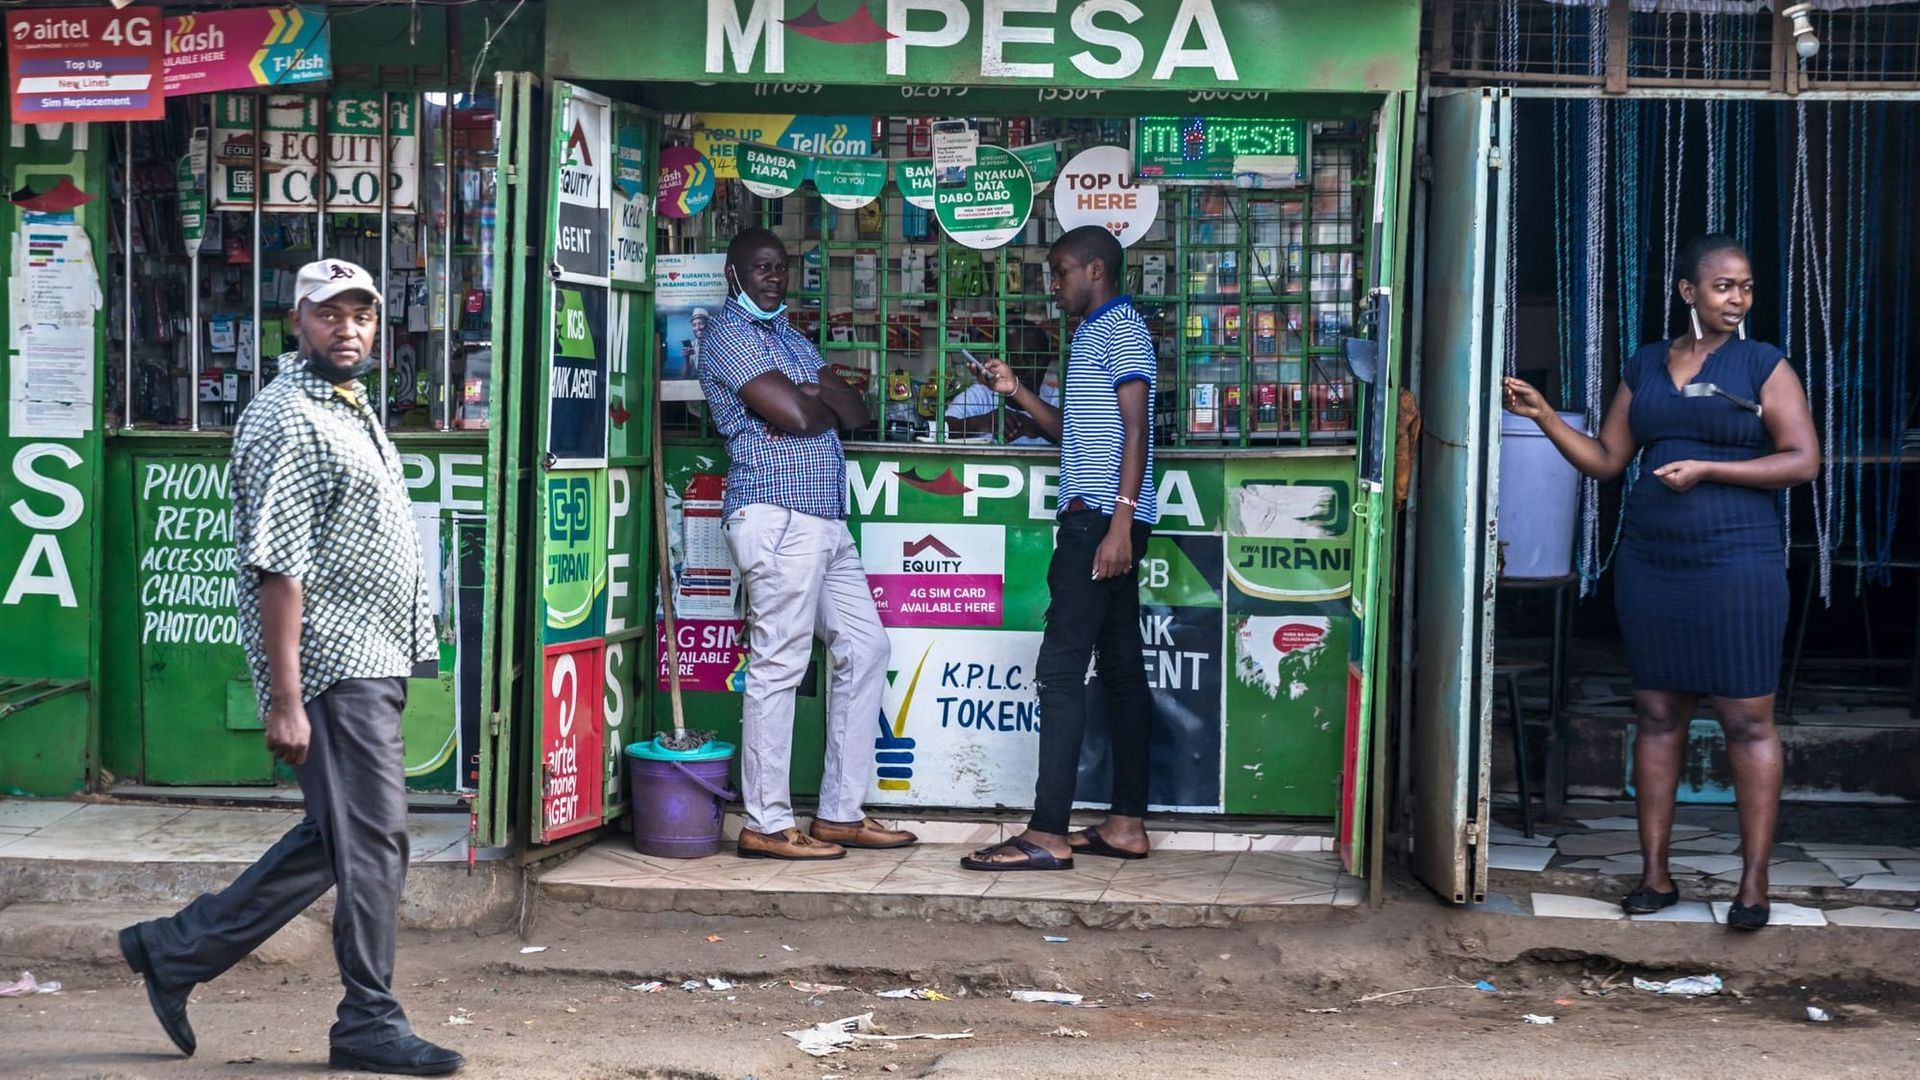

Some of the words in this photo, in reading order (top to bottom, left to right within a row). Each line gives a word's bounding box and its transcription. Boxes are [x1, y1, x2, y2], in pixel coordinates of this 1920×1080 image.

[33, 18, 90, 40] airtel
[102, 17, 152, 46] 4G
[705, 0, 785, 74] M
[886, 0, 1240, 81] PESA
[200, 51, 225, 62] HERE
[65, 60, 84, 71] Top
[87, 60, 103, 71] Up
[58, 79, 80, 88] New
[83, 78, 110, 87] Lines
[41, 98, 62, 108] Sim
[63, 96, 131, 109] Replacement
[705, 128, 735, 142] TOP
[738, 128, 763, 142] UP
[1207, 125, 1295, 154] PESA
[226, 146, 269, 157] EQUIY
[790, 133, 866, 156] Telkom
[747, 151, 797, 170] BAMBA
[751, 163, 789, 180] HAPA
[974, 168, 1025, 181] NYAKUA
[833, 177, 848, 185] FOR
[850, 177, 865, 185] YOU
[975, 181, 1005, 191] DATA
[1066, 173, 1112, 190] TOP
[939, 192, 973, 204] DABO
[977, 190, 1011, 202] DABO
[1077, 193, 1137, 210] HERE
[567, 308, 585, 340] KCB
[571, 370, 597, 400] AGENT
[143, 463, 236, 501] PHON
[847, 461, 900, 515] M
[963, 463, 1206, 527] PEA
[1240, 545, 1261, 554] KWA
[1239, 546, 1351, 571] JIRANI
[903, 560, 962, 573] EQUITY
[909, 588, 927, 598] 4G
[929, 588, 950, 598] SIM
[953, 588, 986, 598] CARD
[900, 602, 962, 613] AVAILABLE
[965, 602, 996, 613] HERE
[660, 651, 731, 664] AAILABLE
[661, 664, 695, 676] HRE
